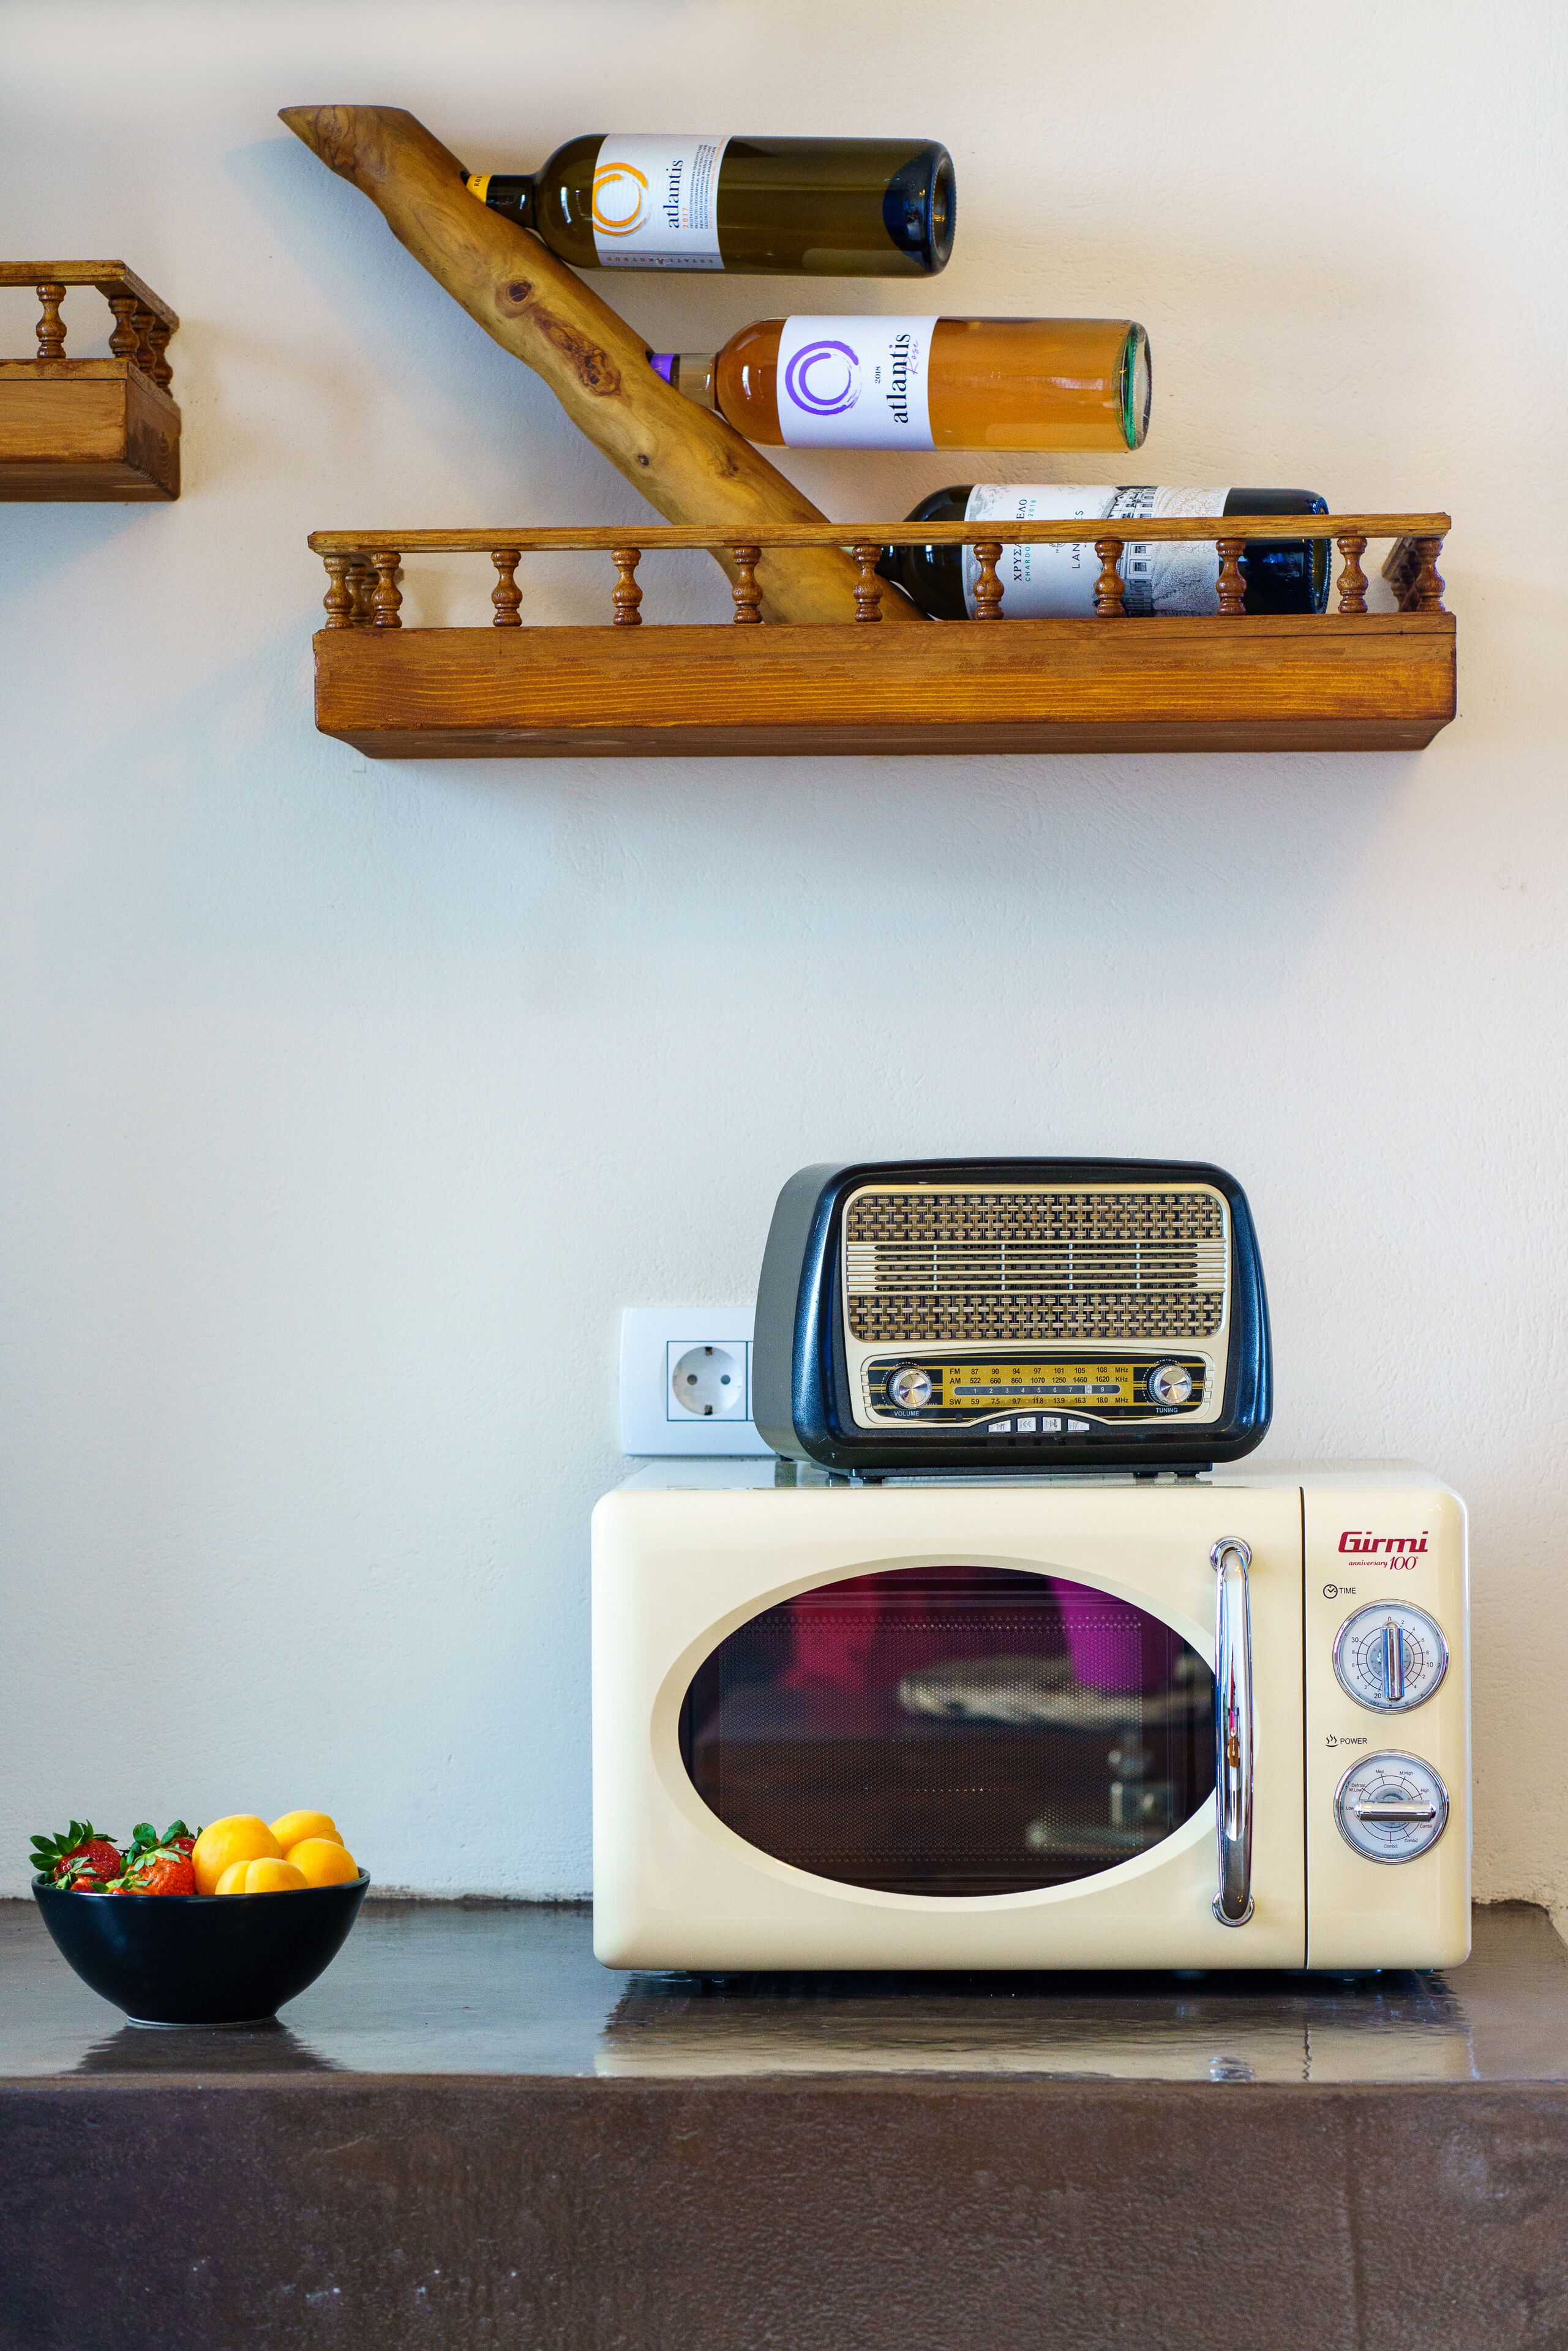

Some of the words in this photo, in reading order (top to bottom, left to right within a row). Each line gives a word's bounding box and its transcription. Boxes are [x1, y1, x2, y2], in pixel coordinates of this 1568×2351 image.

[662, 160, 683, 228] atlantis
[886, 334, 911, 424] atlantis
[1013, 499, 1027, 581] ΧΡΥΣΑΕΛΟ
[1338, 1531, 1428, 1553] Girmi
